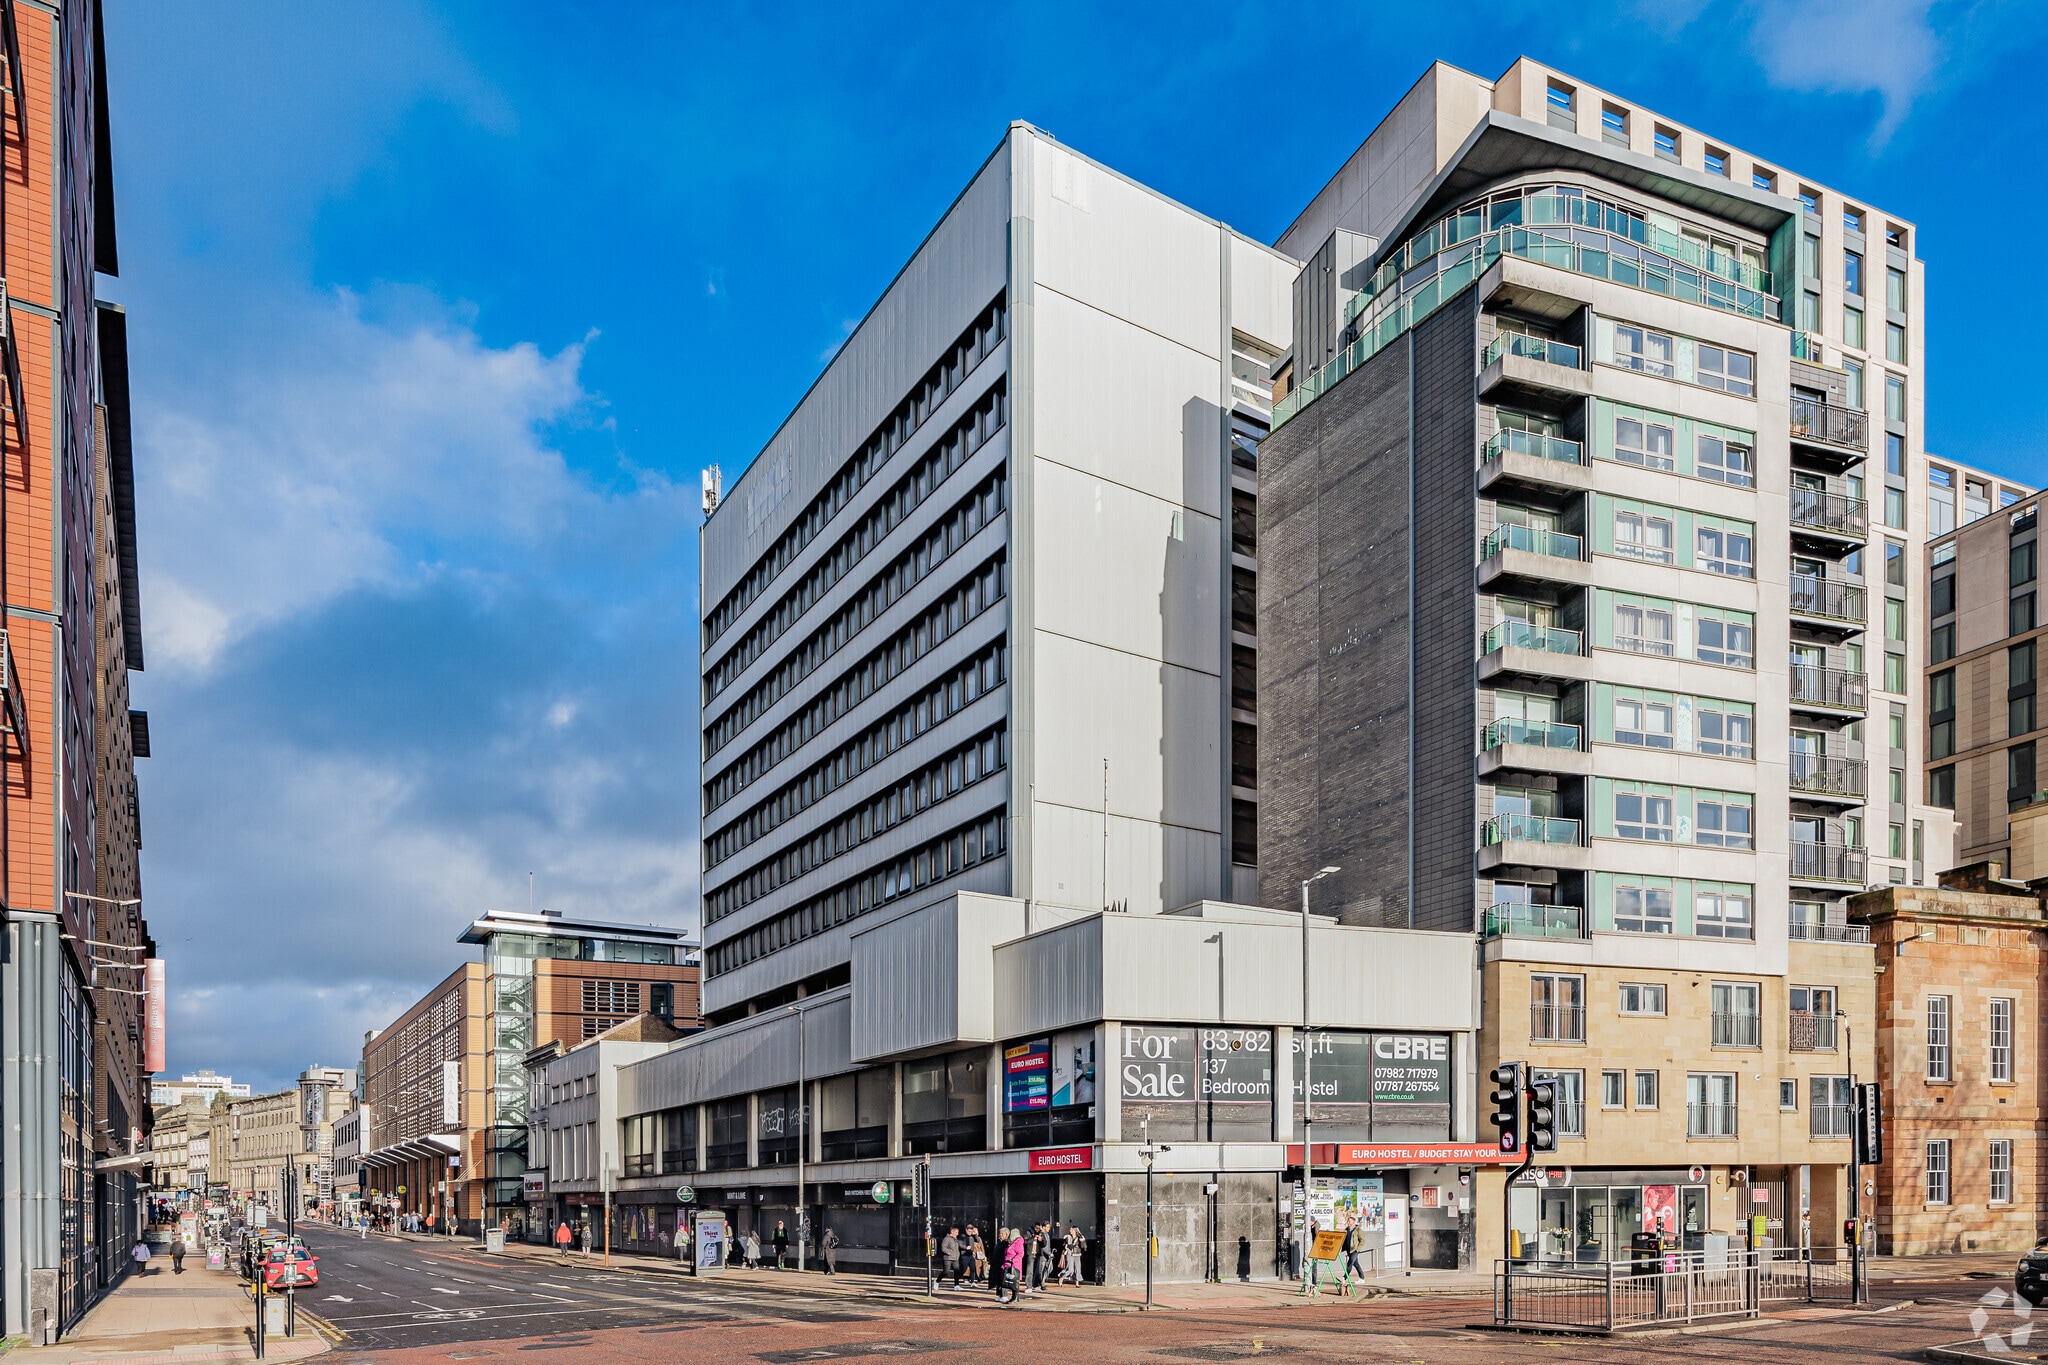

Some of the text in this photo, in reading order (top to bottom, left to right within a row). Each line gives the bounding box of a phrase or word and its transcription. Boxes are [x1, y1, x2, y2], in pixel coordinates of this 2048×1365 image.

[1122, 1026, 1178, 1059] For
[1202, 1029, 1270, 1054] 83,782
[1374, 1036, 1447, 1060] CBRE
[1011, 1057, 1044, 1069] EURO HOSTEL
[1202, 1058, 1227, 1074] 137
[1122, 1063, 1185, 1097] Sale
[1374, 1067, 1438, 1079] 07982 717979
[447, 1065, 455, 1120] MATALAN
[1202, 1078, 1270, 1094] Bedroom
[1374, 1080, 1440, 1092] 07787 267554
[1038, 1153, 1082, 1165] EURO HOSTEL
[1352, 1150, 1376, 1158] EURO
[1377, 1149, 1412, 1158] HOSTEL
[1413, 1149, 1418, 1158] /
[1419, 1149, 1451, 1158] BUDGET
[1453, 1149, 1472, 1158] STAY
[1472, 1149, 1497, 1157] YOUR
[1424, 1189, 1437, 1206] EH!
